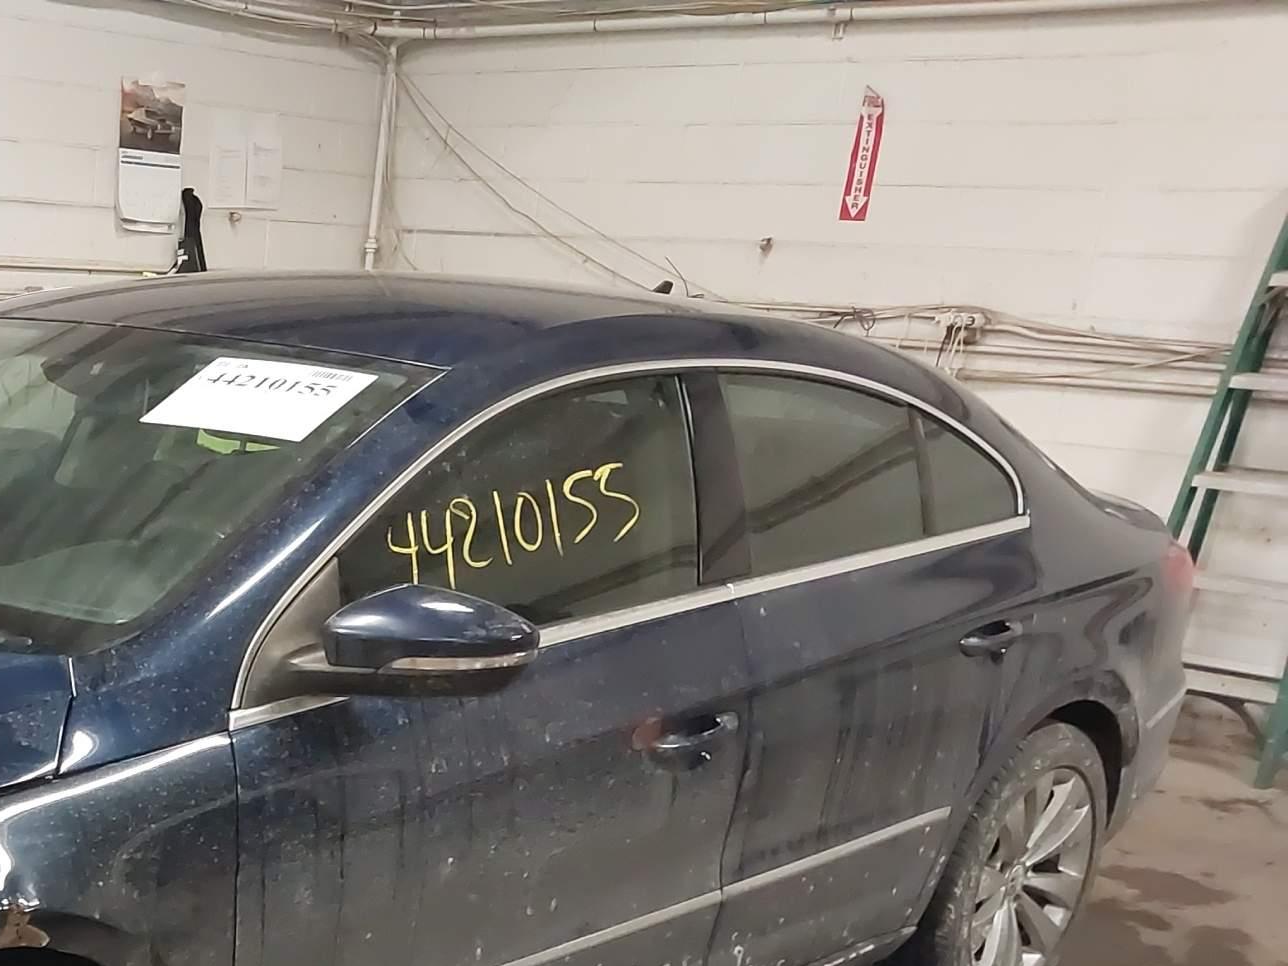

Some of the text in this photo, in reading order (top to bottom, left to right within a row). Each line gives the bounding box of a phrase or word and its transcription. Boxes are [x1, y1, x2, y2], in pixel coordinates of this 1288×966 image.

[851, 113, 873, 210] EXTINGUISHER
[207, 372, 338, 396] 44210155
[387, 463, 639, 590] 44210155
